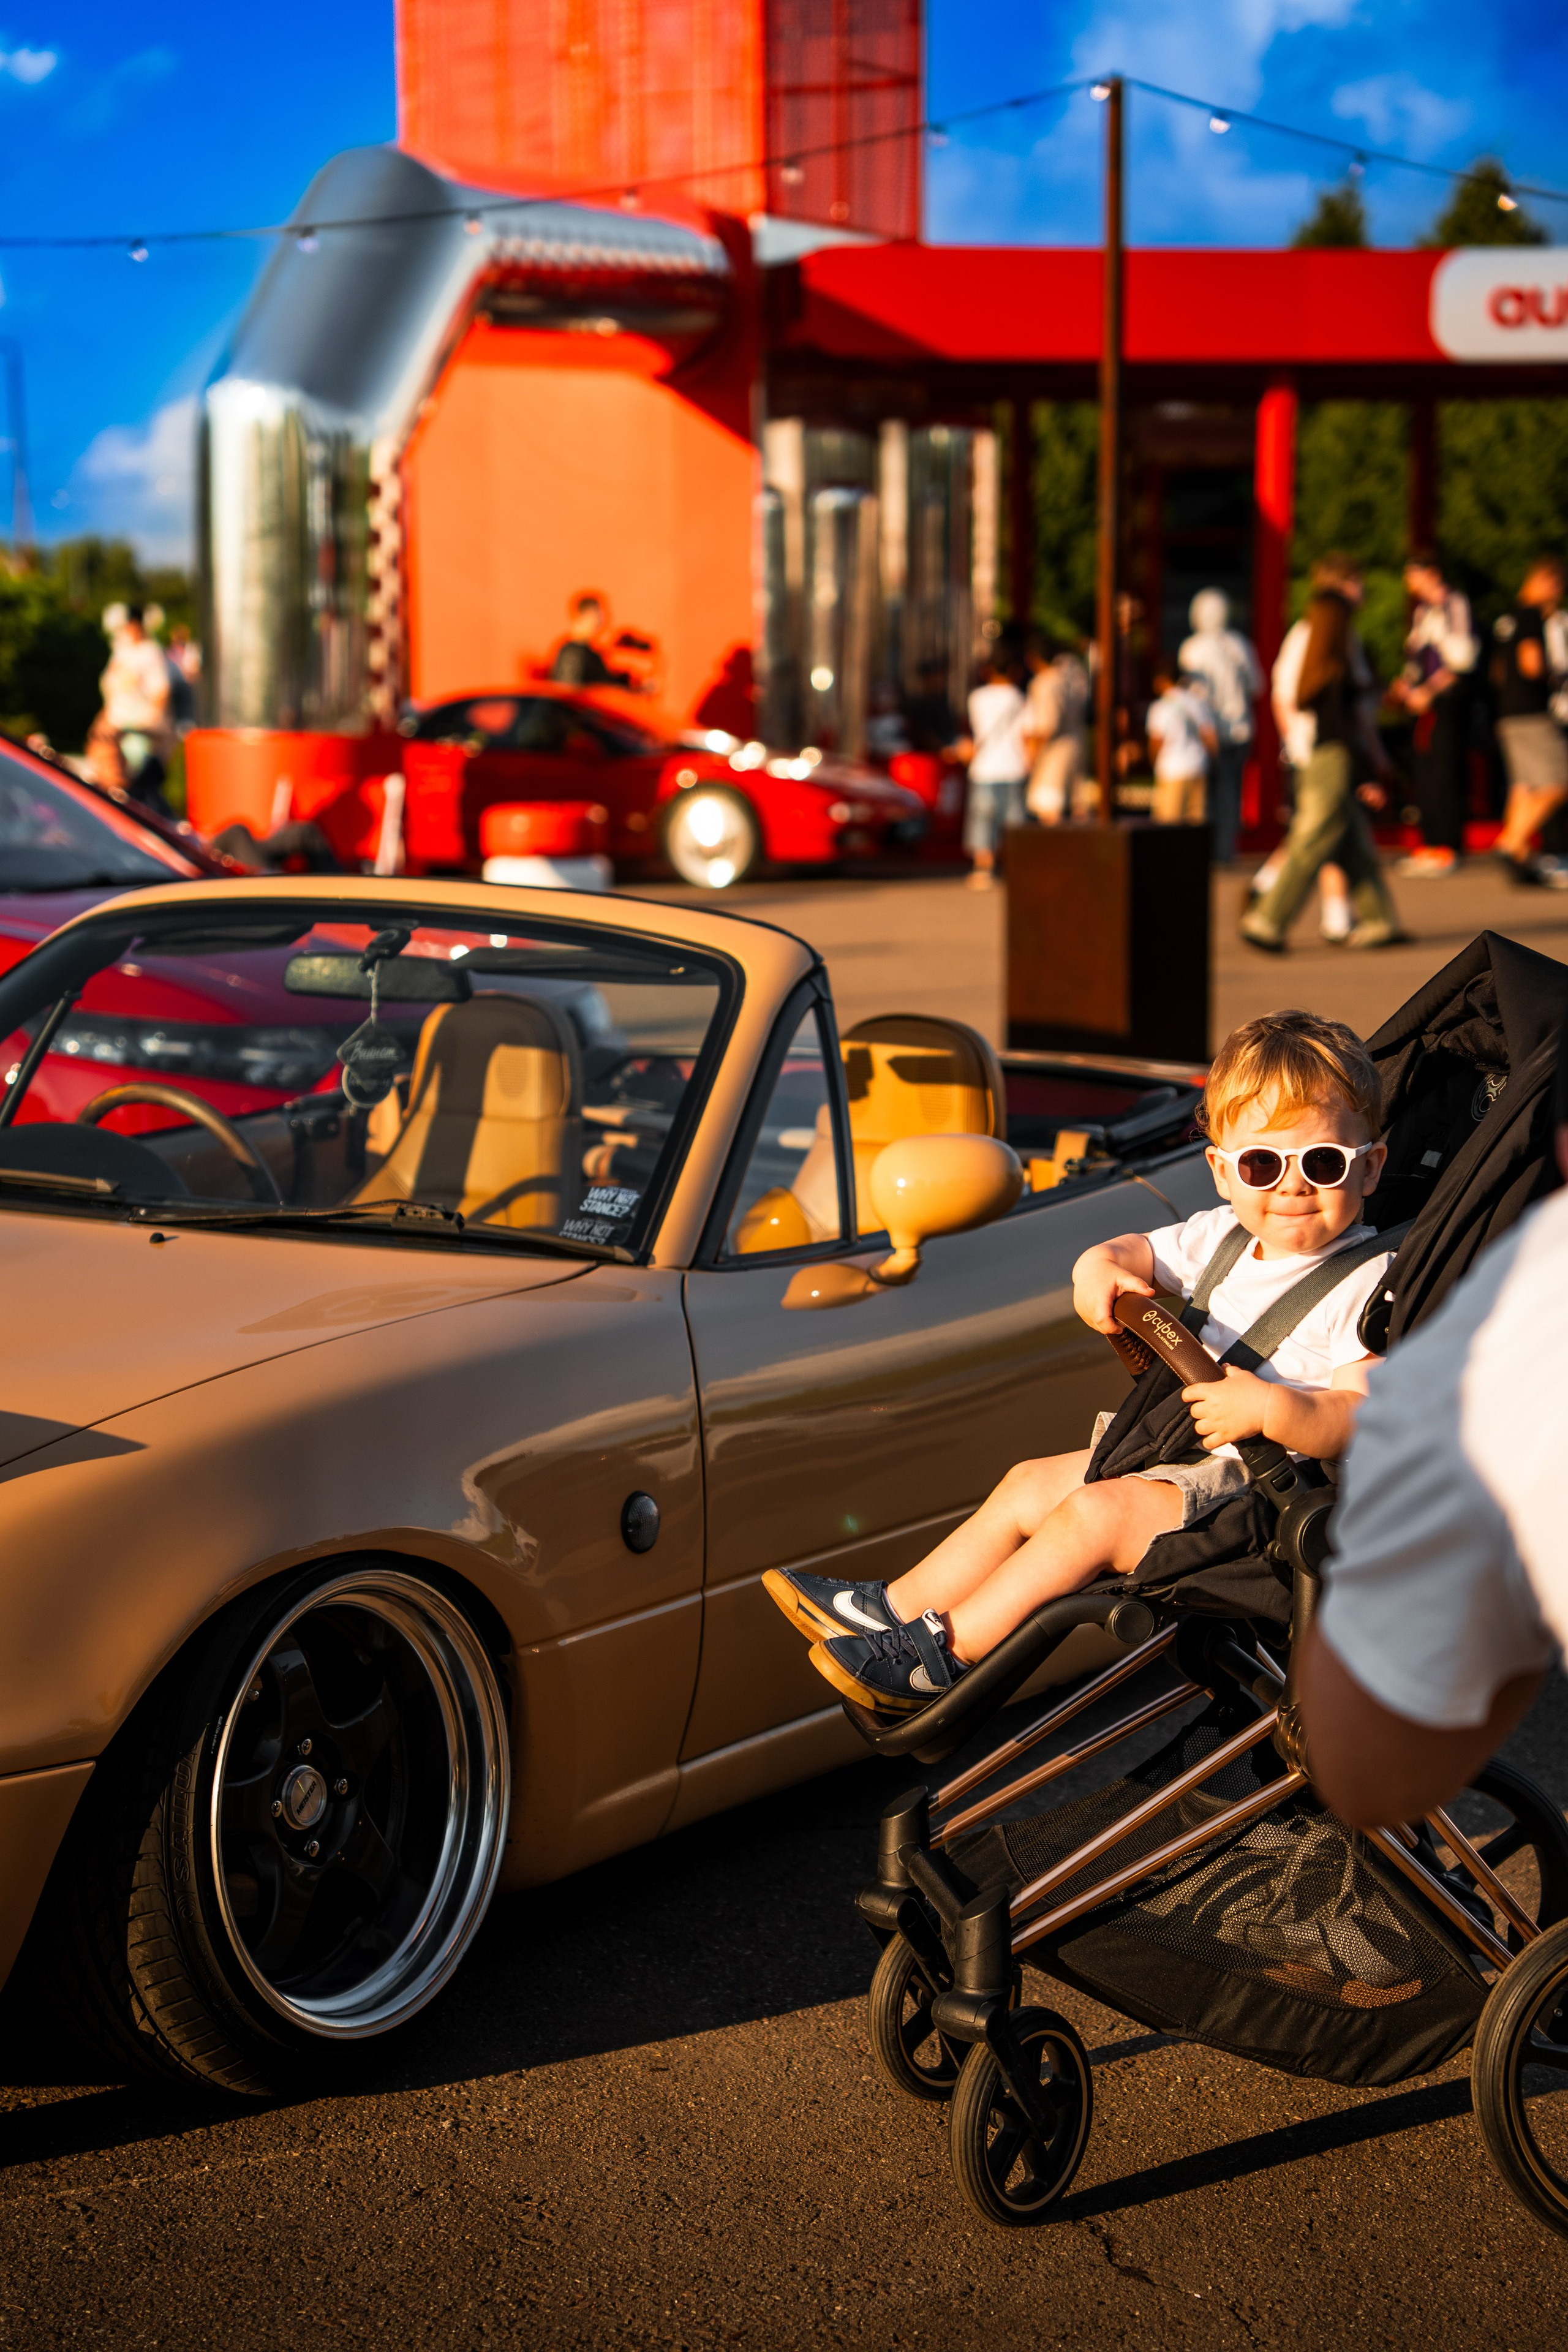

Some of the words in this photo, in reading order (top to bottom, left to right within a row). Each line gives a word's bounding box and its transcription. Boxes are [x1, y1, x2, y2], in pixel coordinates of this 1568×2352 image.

[1485, 284, 1568, 329] au
[587, 1186, 619, 1201] WHY
[614, 1191, 641, 1206] NOT
[579, 1198, 630, 1218] STANCE?
[562, 1218, 594, 1234] WHY
[589, 1223, 615, 1238] NOT
[1152, 1317, 1183, 1346] cybex
[1156, 1332, 1174, 1351] PLATINUM
[296, 1781, 317, 1815] MEISTER
